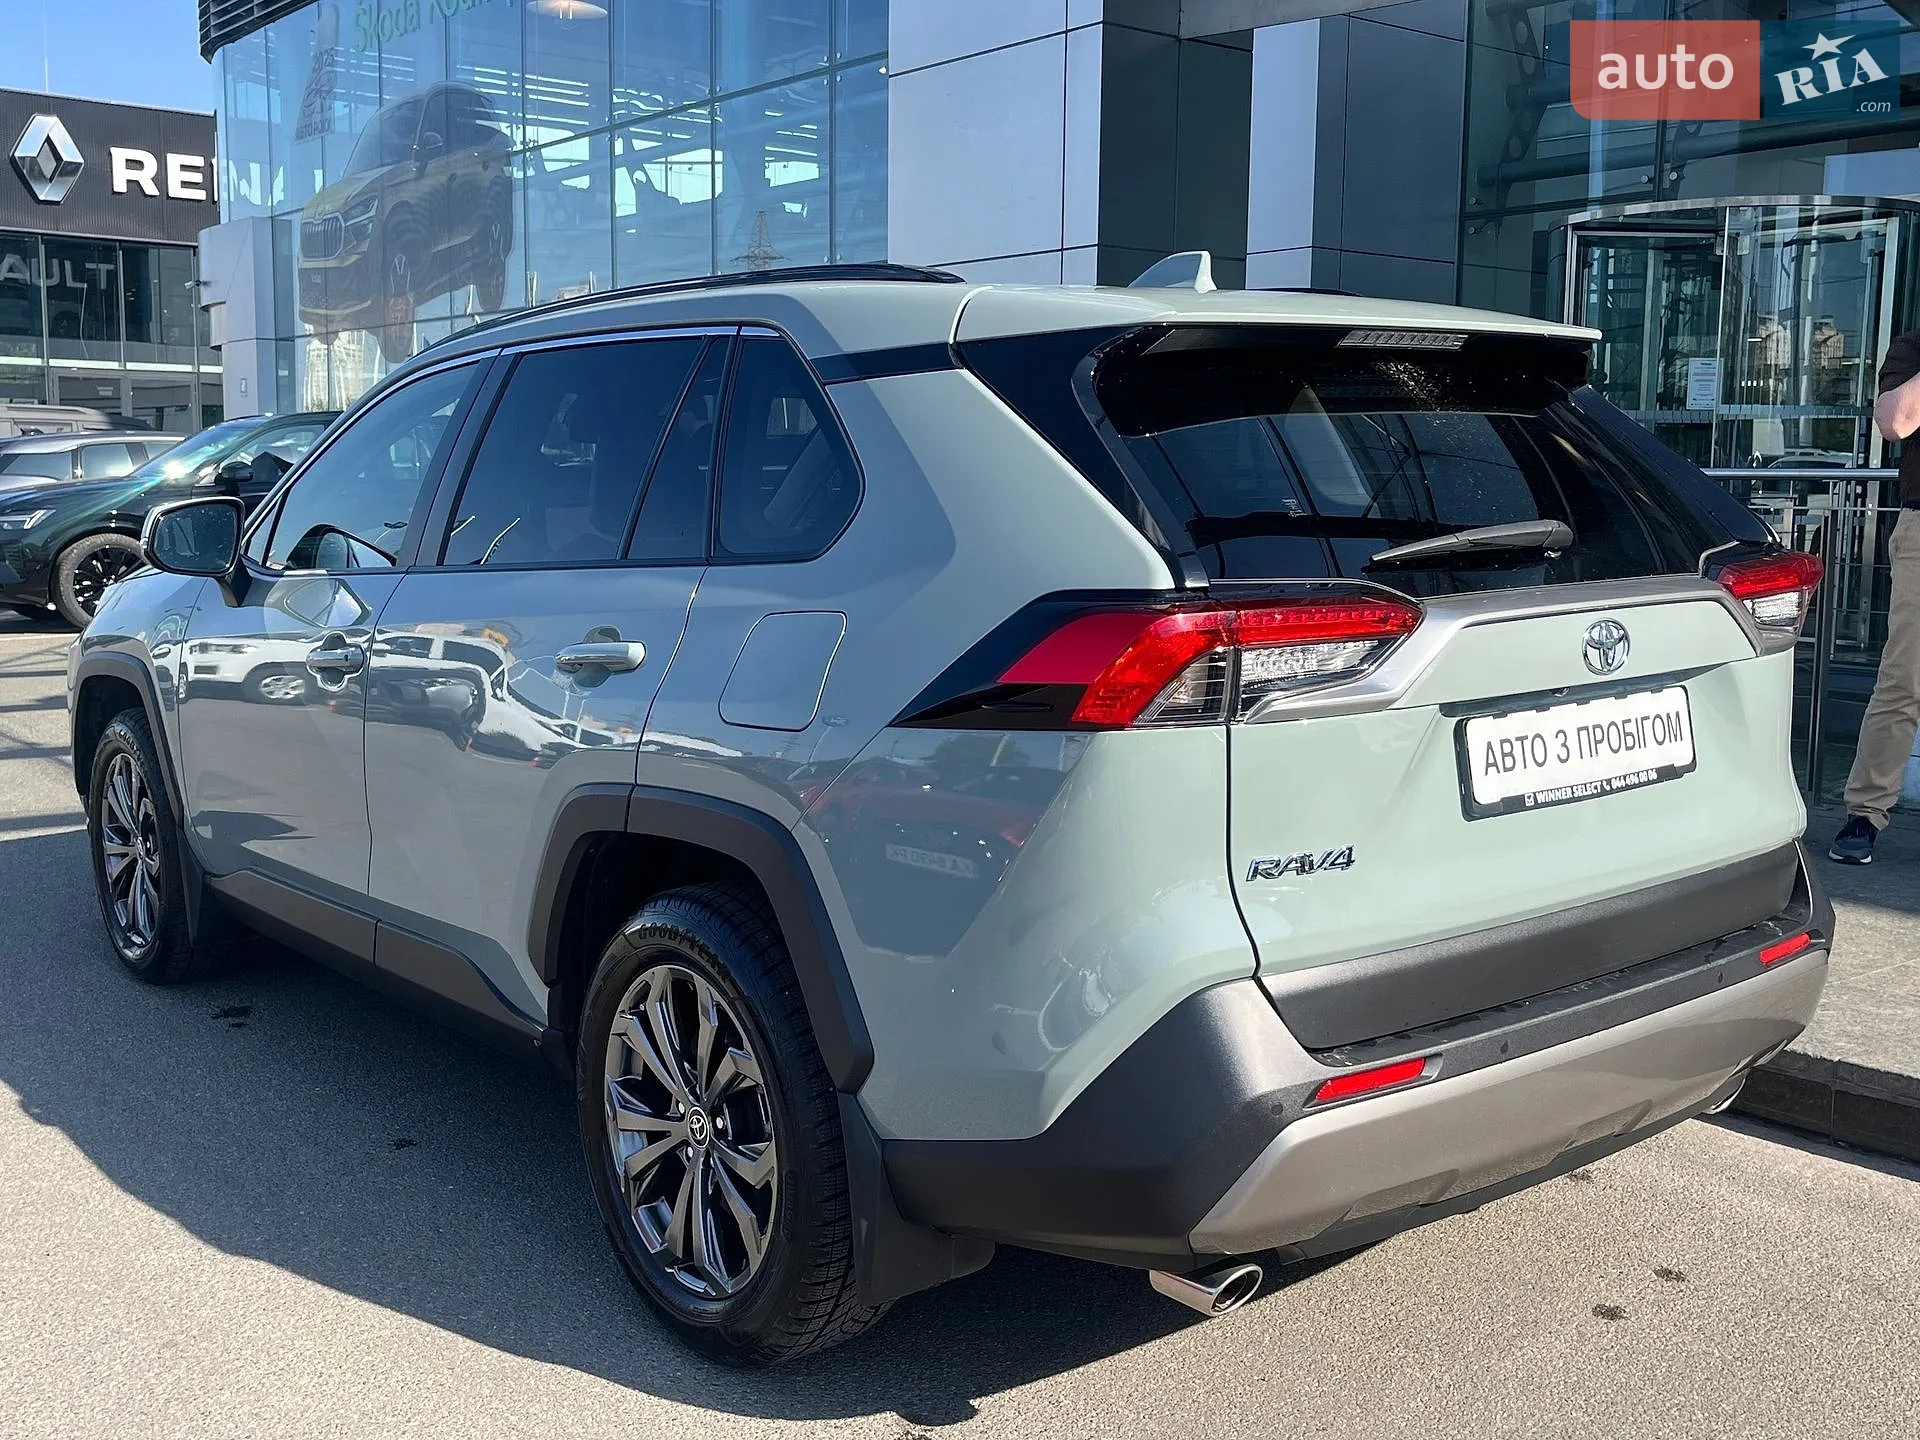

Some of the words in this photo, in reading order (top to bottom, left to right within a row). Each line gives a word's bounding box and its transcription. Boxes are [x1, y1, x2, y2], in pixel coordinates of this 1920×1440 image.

[1484, 732, 1548, 776] АВТО
[1576, 710, 1684, 760] ПРОБІГОМ
[1535, 787, 1573, 804] WINNER
[1573, 780, 1602, 798] SELECT
[1245, 844, 1356, 882] RAV4
